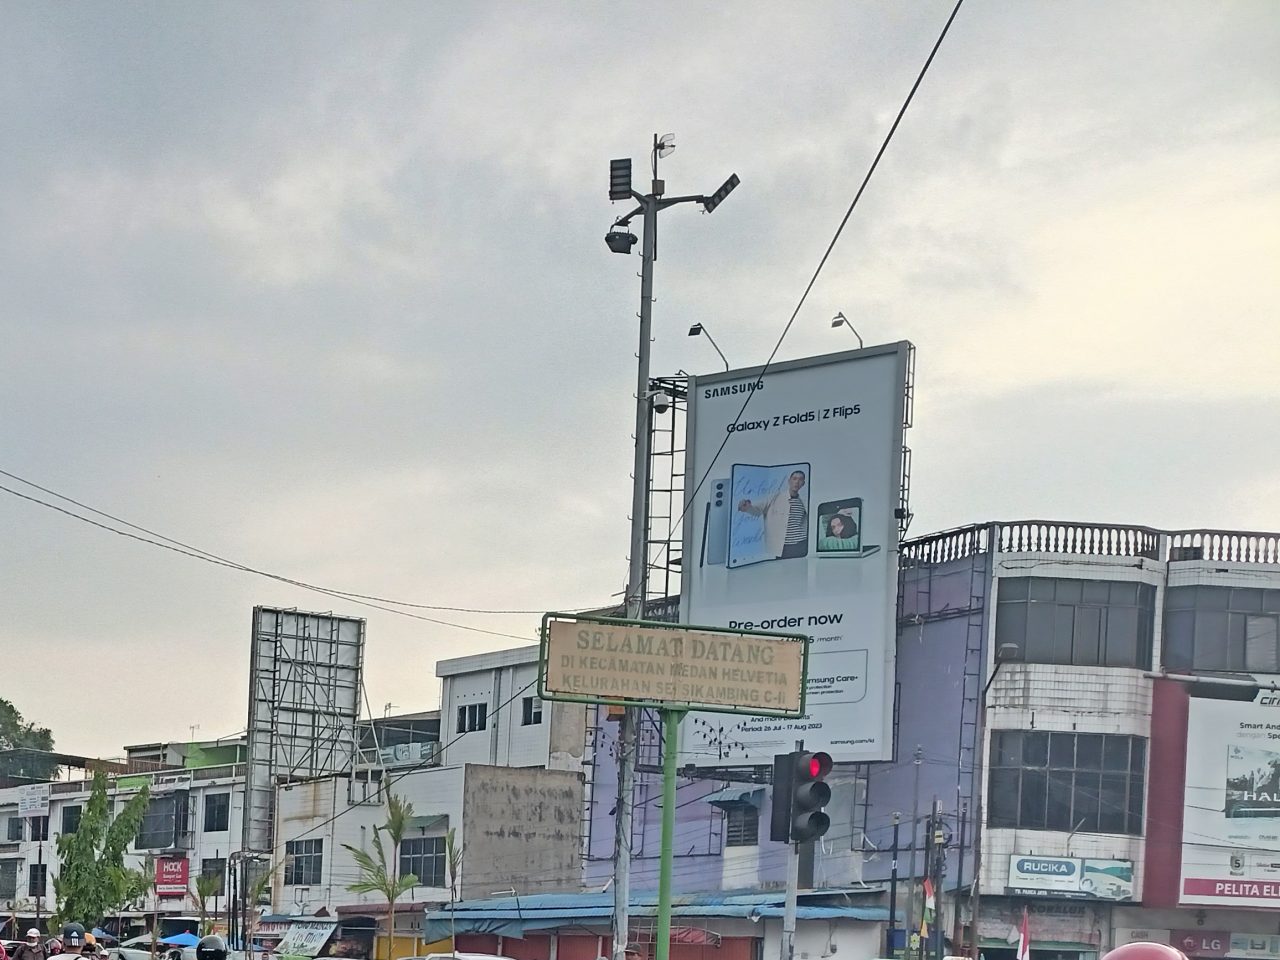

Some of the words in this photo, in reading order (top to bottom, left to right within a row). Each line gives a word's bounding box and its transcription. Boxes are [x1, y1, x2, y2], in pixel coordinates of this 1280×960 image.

[704, 380, 764, 399] SAMSUNG
[726, 416, 770, 433] Galaxy
[773, 416, 780, 427] Z
[782, 411, 815, 425] Fold5
[822, 409, 831, 419] Z
[832, 404, 861, 419] Flip5
[728, 615, 804, 630] Pre-order
[807, 613, 844, 627] now
[576, 630, 684, 659] SELAMAT
[690, 639, 775, 666] DATANG
[560, 655, 575, 669] DI
[578, 656, 666, 677] KECAMATAN
[669, 662, 718, 679] MEDAN
[722, 665, 788, 686] HELVETIA
[562, 673, 652, 696] KELURAHAN
[681, 680, 760, 702] SIKAMBING
[1239, 722, 1264, 730] Smart
[1023, 861, 1068, 873] RUCIKA
[1215, 883, 1260, 896] PELITA
[1263, 885, 1280, 897] EL
[1201, 939, 1221, 950] LG
